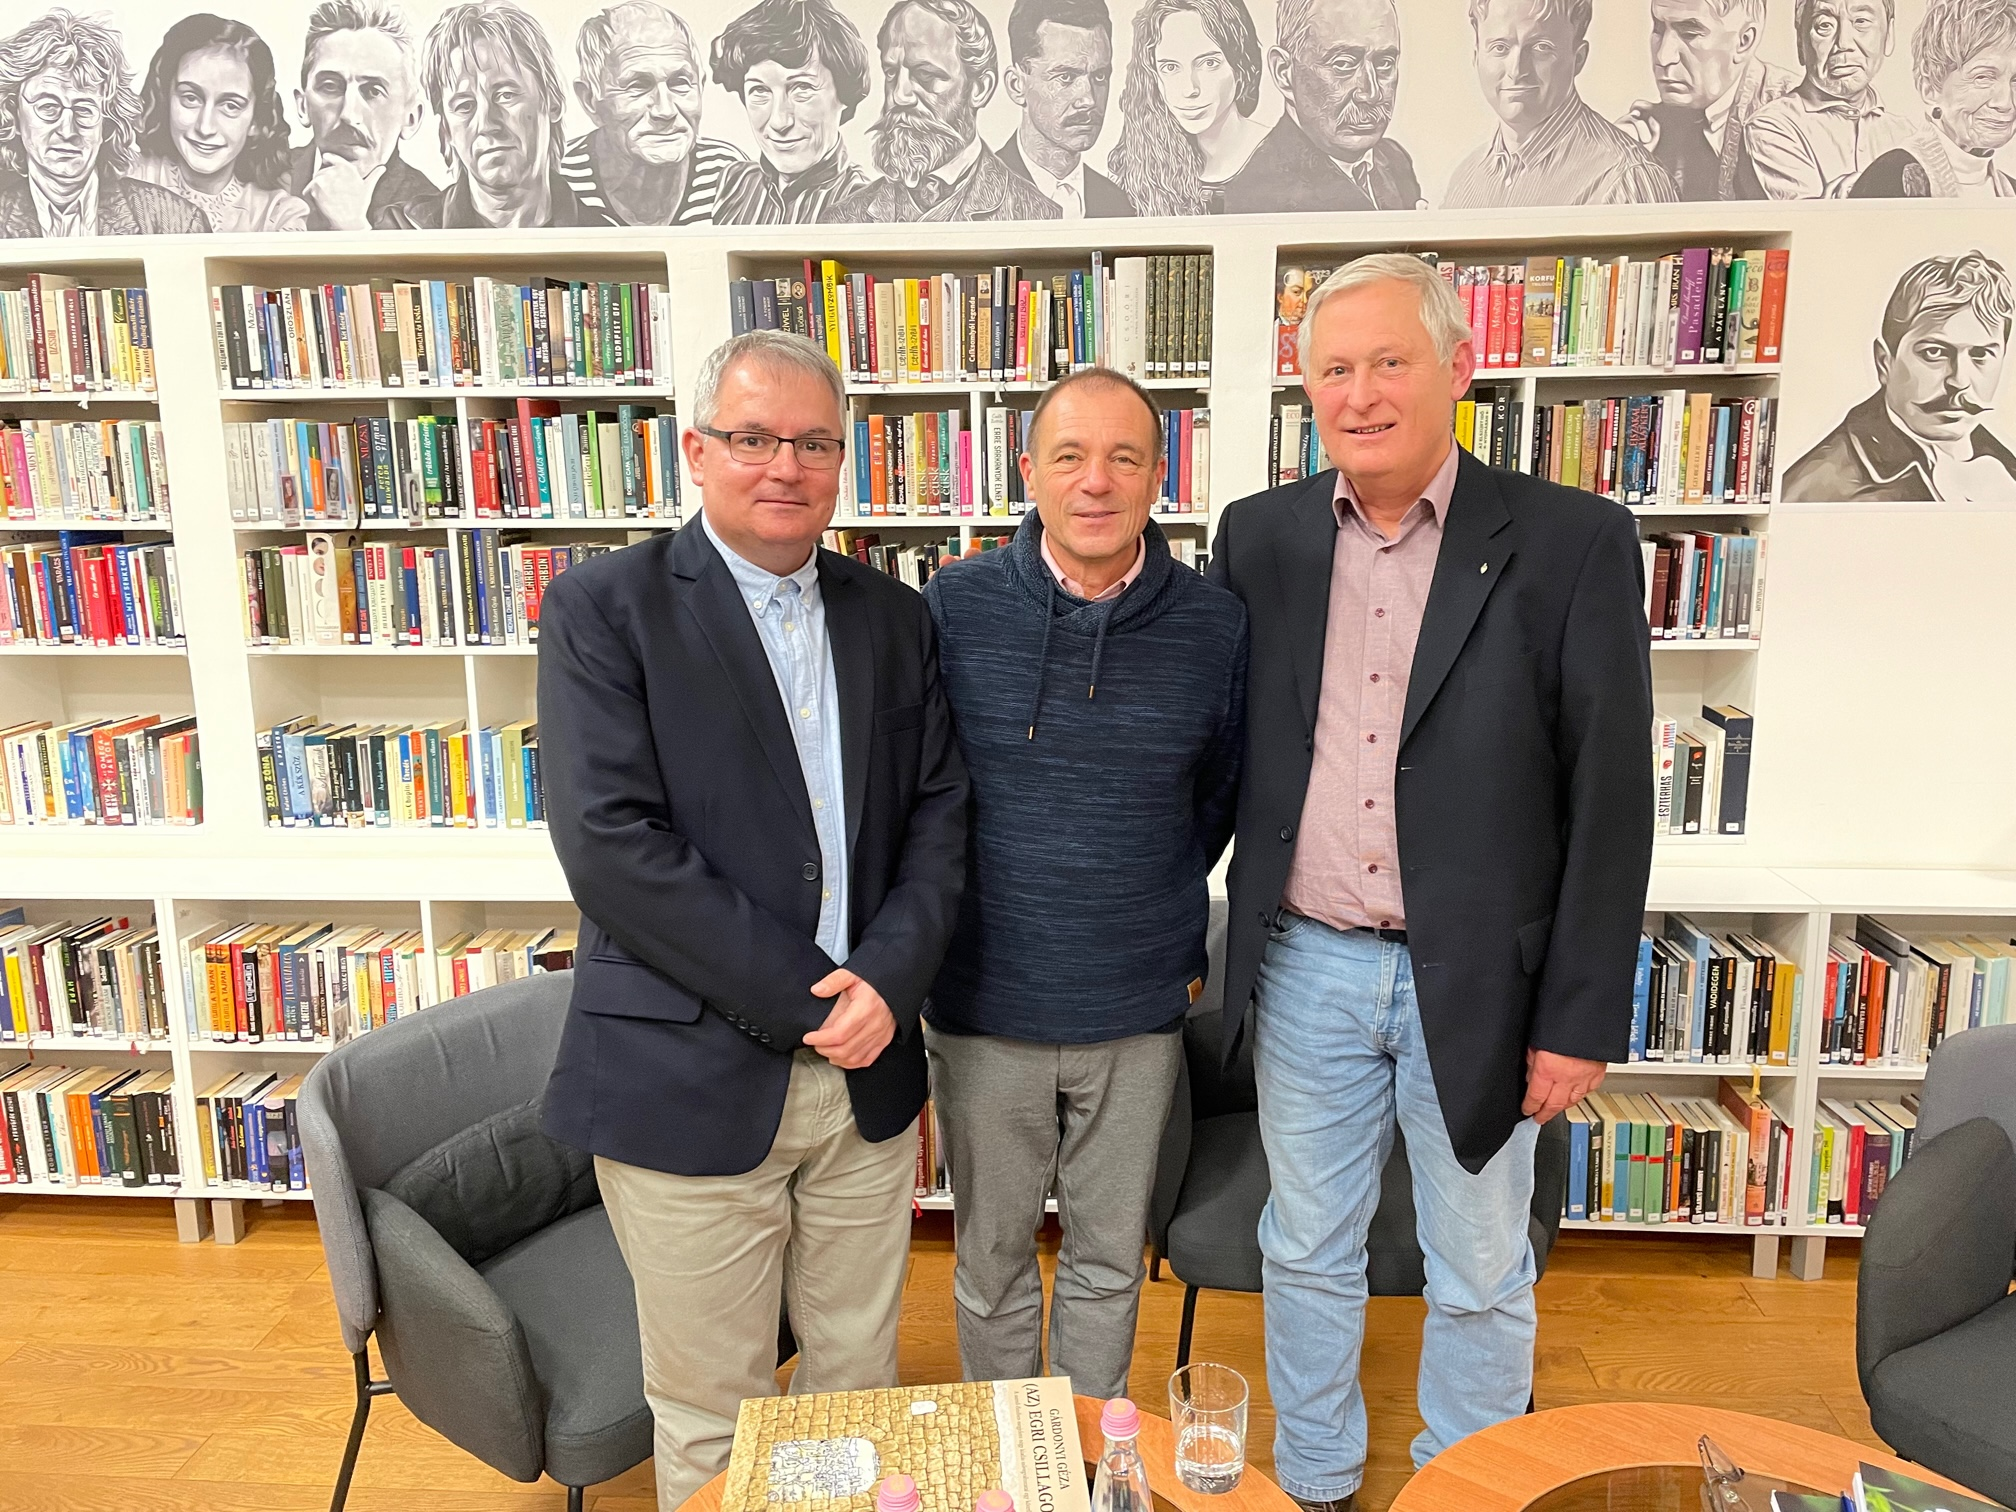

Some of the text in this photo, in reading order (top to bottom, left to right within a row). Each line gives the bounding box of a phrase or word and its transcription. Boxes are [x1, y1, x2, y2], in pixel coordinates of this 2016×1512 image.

[968, 296, 976, 322] legenda
[1688, 268, 1704, 334] Pasadena
[1715, 313, 1724, 332] DÁN
[614, 321, 622, 363] BUDAPEST
[1497, 425, 1504, 433] A
[537, 457, 546, 483] CAMUS
[116, 550, 133, 612] MINT SENKI MÁS
[524, 558, 534, 592] CHABON
[261, 755, 275, 808] ZÖLD ZÓNA
[220, 970, 228, 995] TAJPAN
[382, 955, 393, 983] HIPPI
[67, 981, 77, 1004] HYPE
[1709, 965, 1720, 1009] VADIDEGEN
[1023, 1383, 1041, 1408] (AZ)
[1029, 1410, 1046, 1441] EGRI
[1050, 1408, 1072, 1491] GÁRDONYI GÉZA
